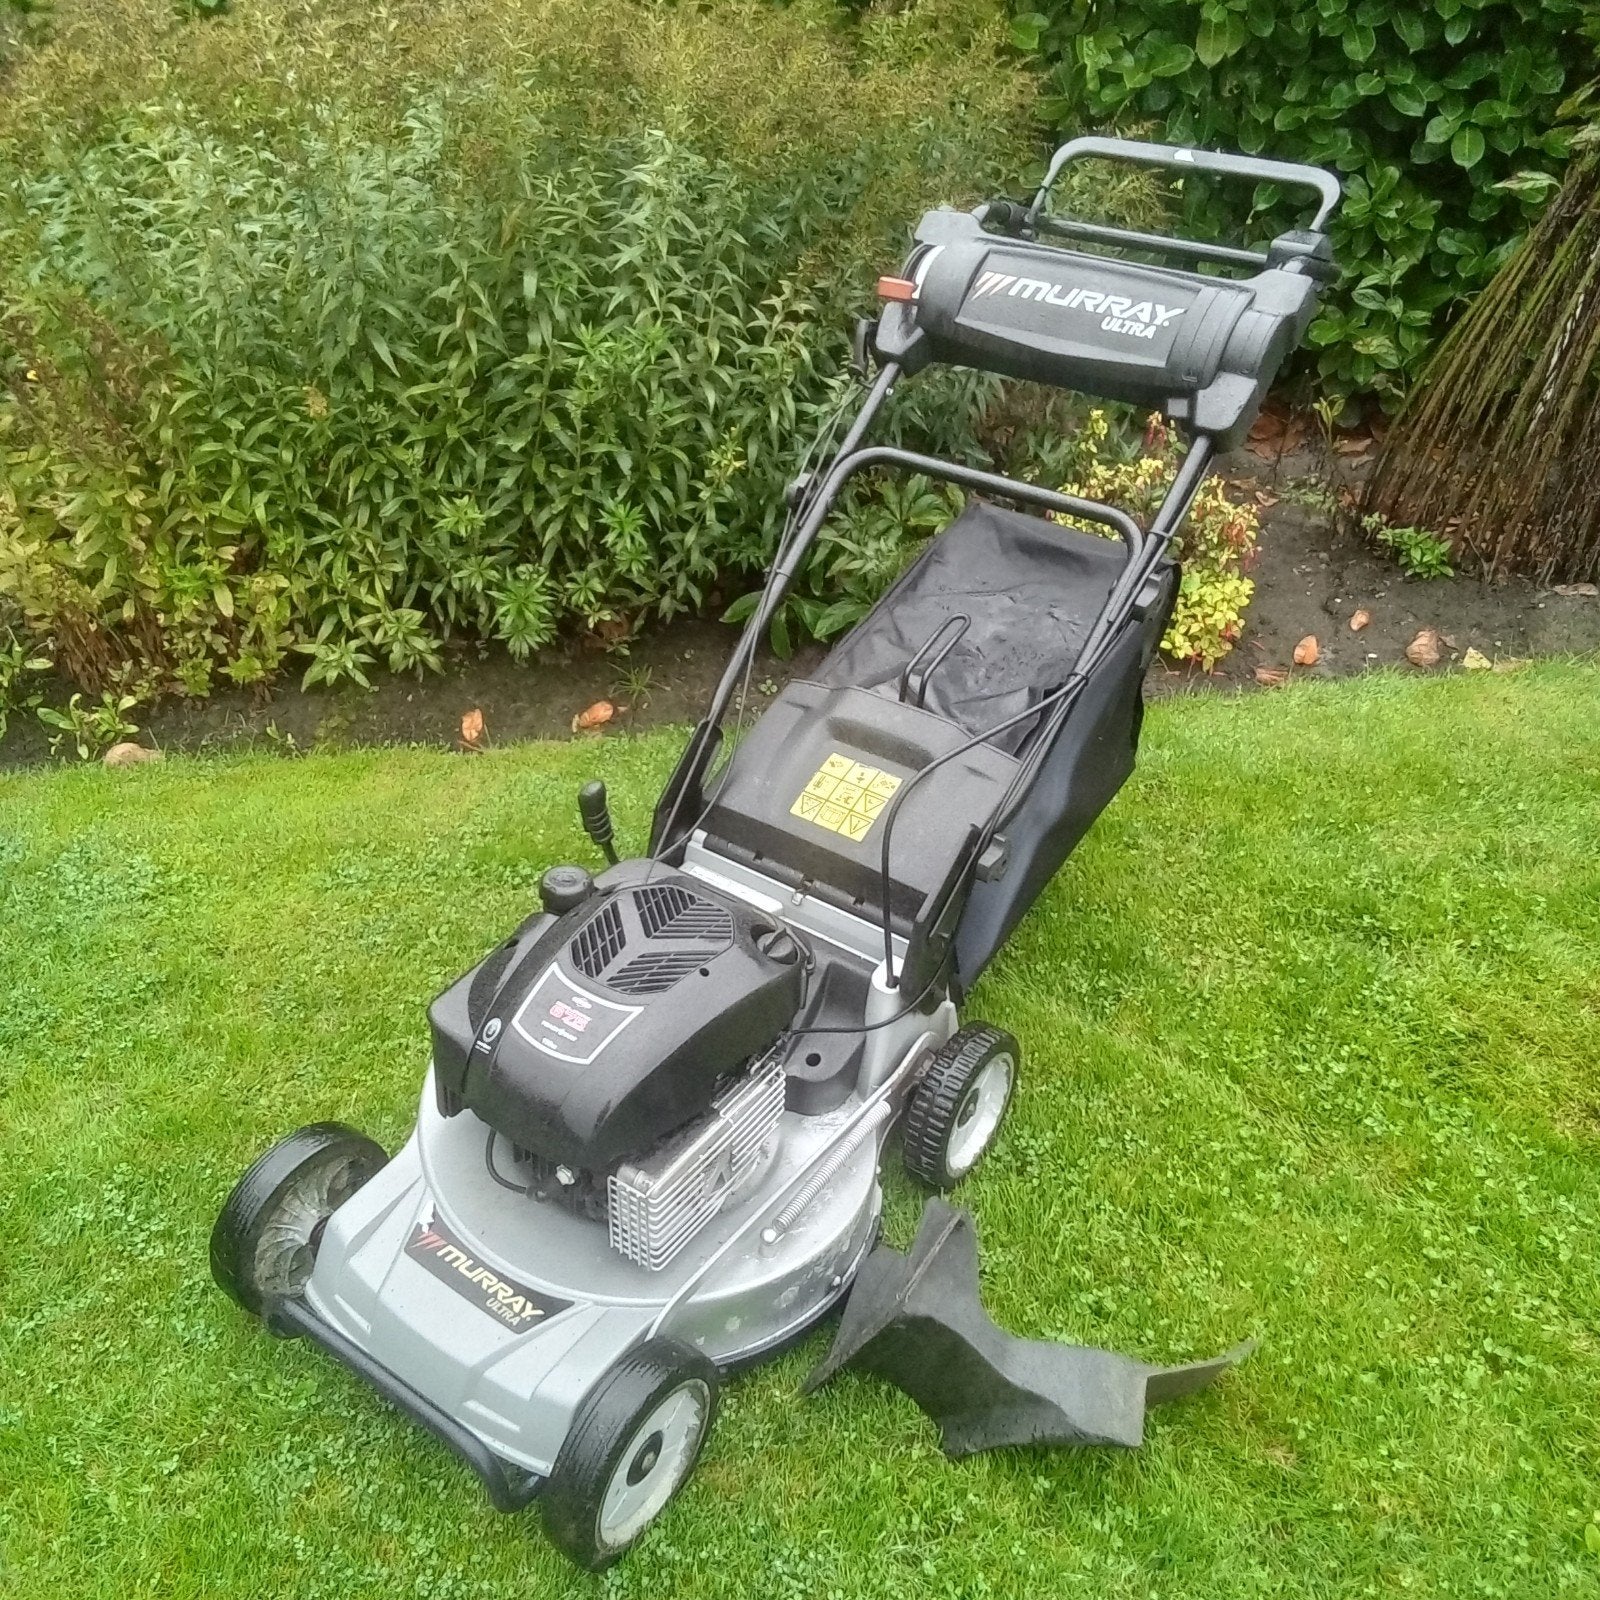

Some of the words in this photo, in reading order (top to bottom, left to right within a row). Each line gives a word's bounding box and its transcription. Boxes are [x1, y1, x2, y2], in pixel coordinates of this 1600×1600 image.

[1007, 277, 1187, 326] MURRAY
[1100, 316, 1157, 339] ULTRA
[436, 1244, 545, 1319] MURRAY
[485, 1297, 522, 1326] ULTRA
